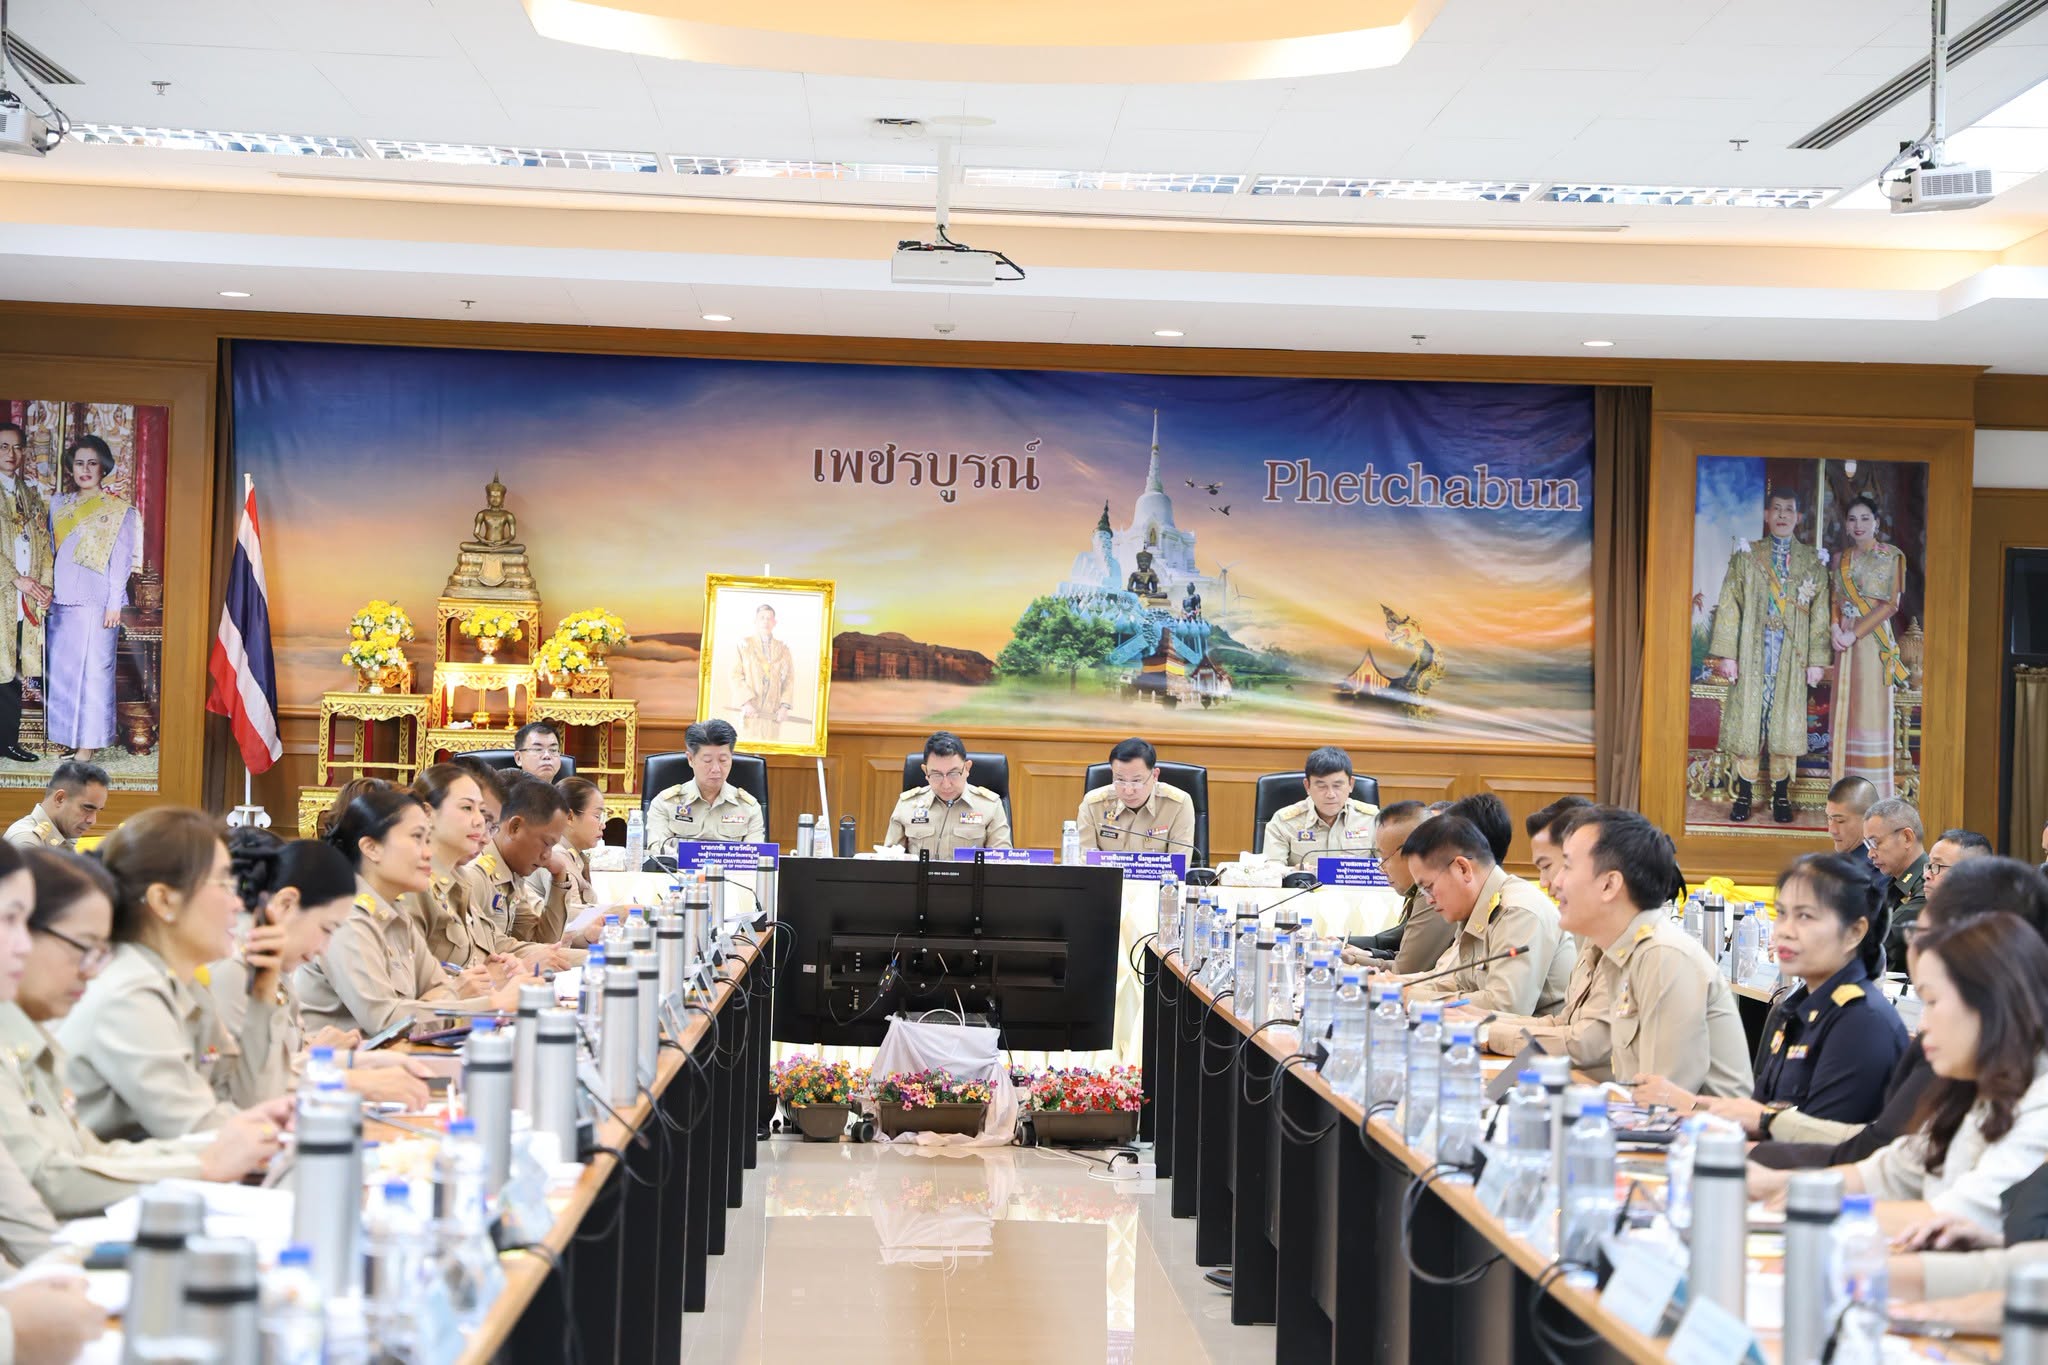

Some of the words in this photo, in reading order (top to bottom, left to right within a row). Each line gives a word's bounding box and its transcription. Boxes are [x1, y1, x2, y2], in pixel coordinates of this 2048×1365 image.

[813, 438, 1041, 503] เพชรบูรณ์
[1263, 458, 1583, 512] Phetchabun
